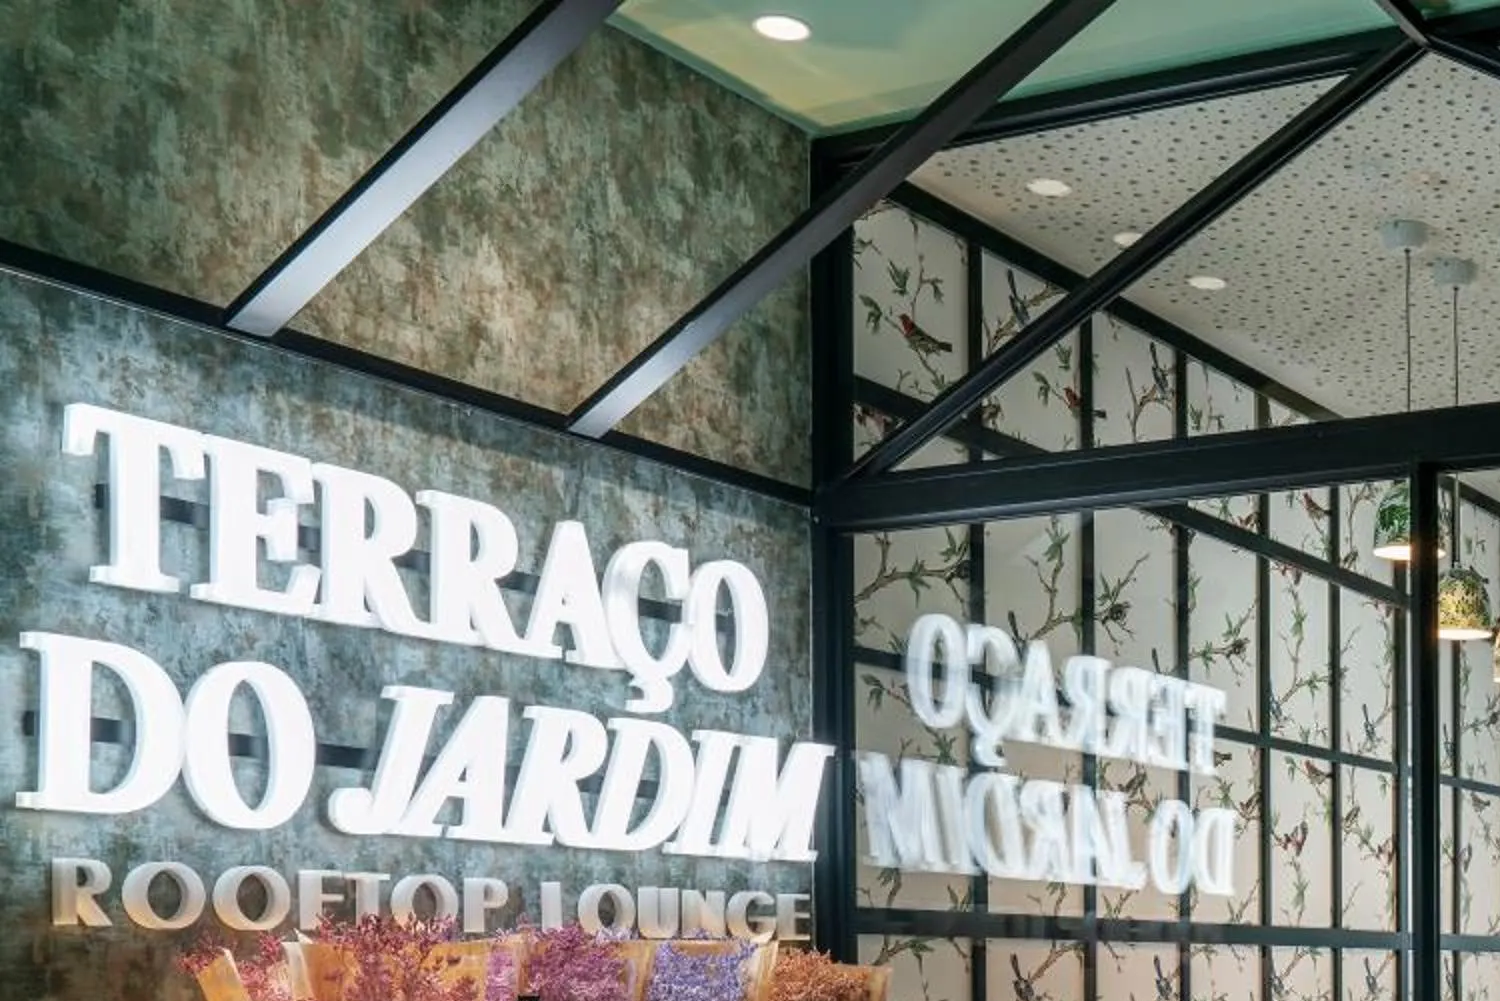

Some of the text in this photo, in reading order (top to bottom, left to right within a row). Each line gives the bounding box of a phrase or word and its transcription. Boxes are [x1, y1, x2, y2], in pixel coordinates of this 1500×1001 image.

[62, 402, 770, 712] TERRAÇO
[14, 630, 835, 862] DO JARDIM
[51, 857, 812, 943] ROOFTOP LOUNGE
